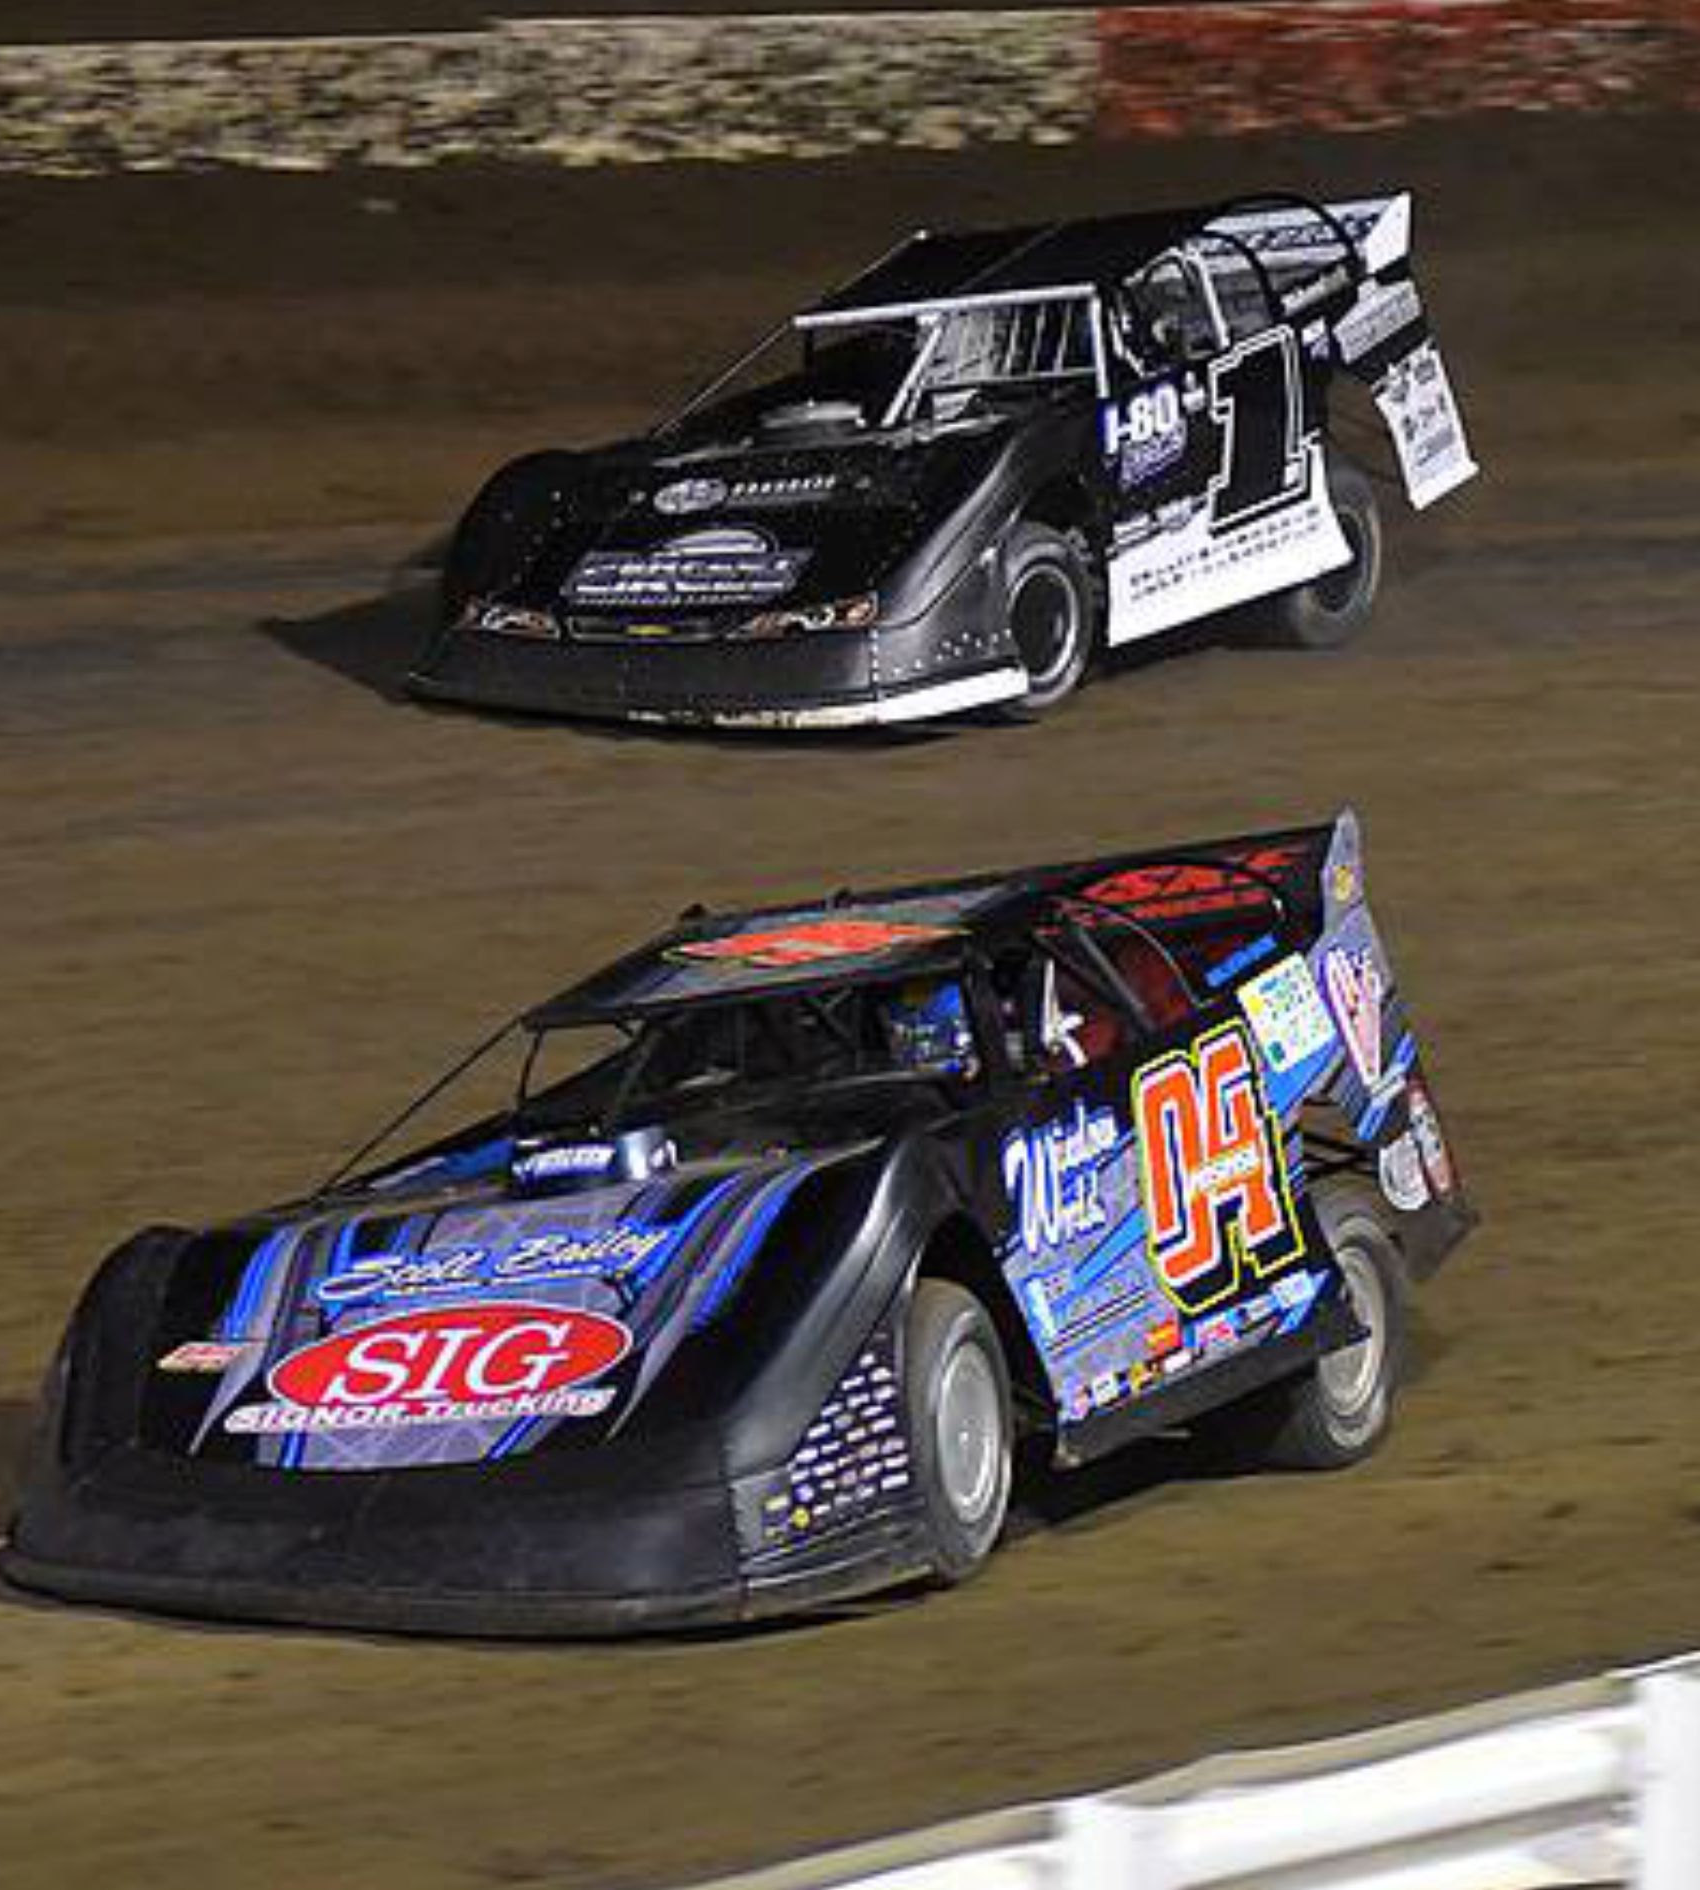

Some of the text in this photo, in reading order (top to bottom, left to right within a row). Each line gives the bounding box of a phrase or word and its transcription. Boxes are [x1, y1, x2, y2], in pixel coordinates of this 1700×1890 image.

[1208, 325, 1310, 535] 1
[1135, 1020, 1295, 1305] 04
[317, 1226, 668, 1300] Scott Bailey
[325, 1319, 573, 1404] SIG
